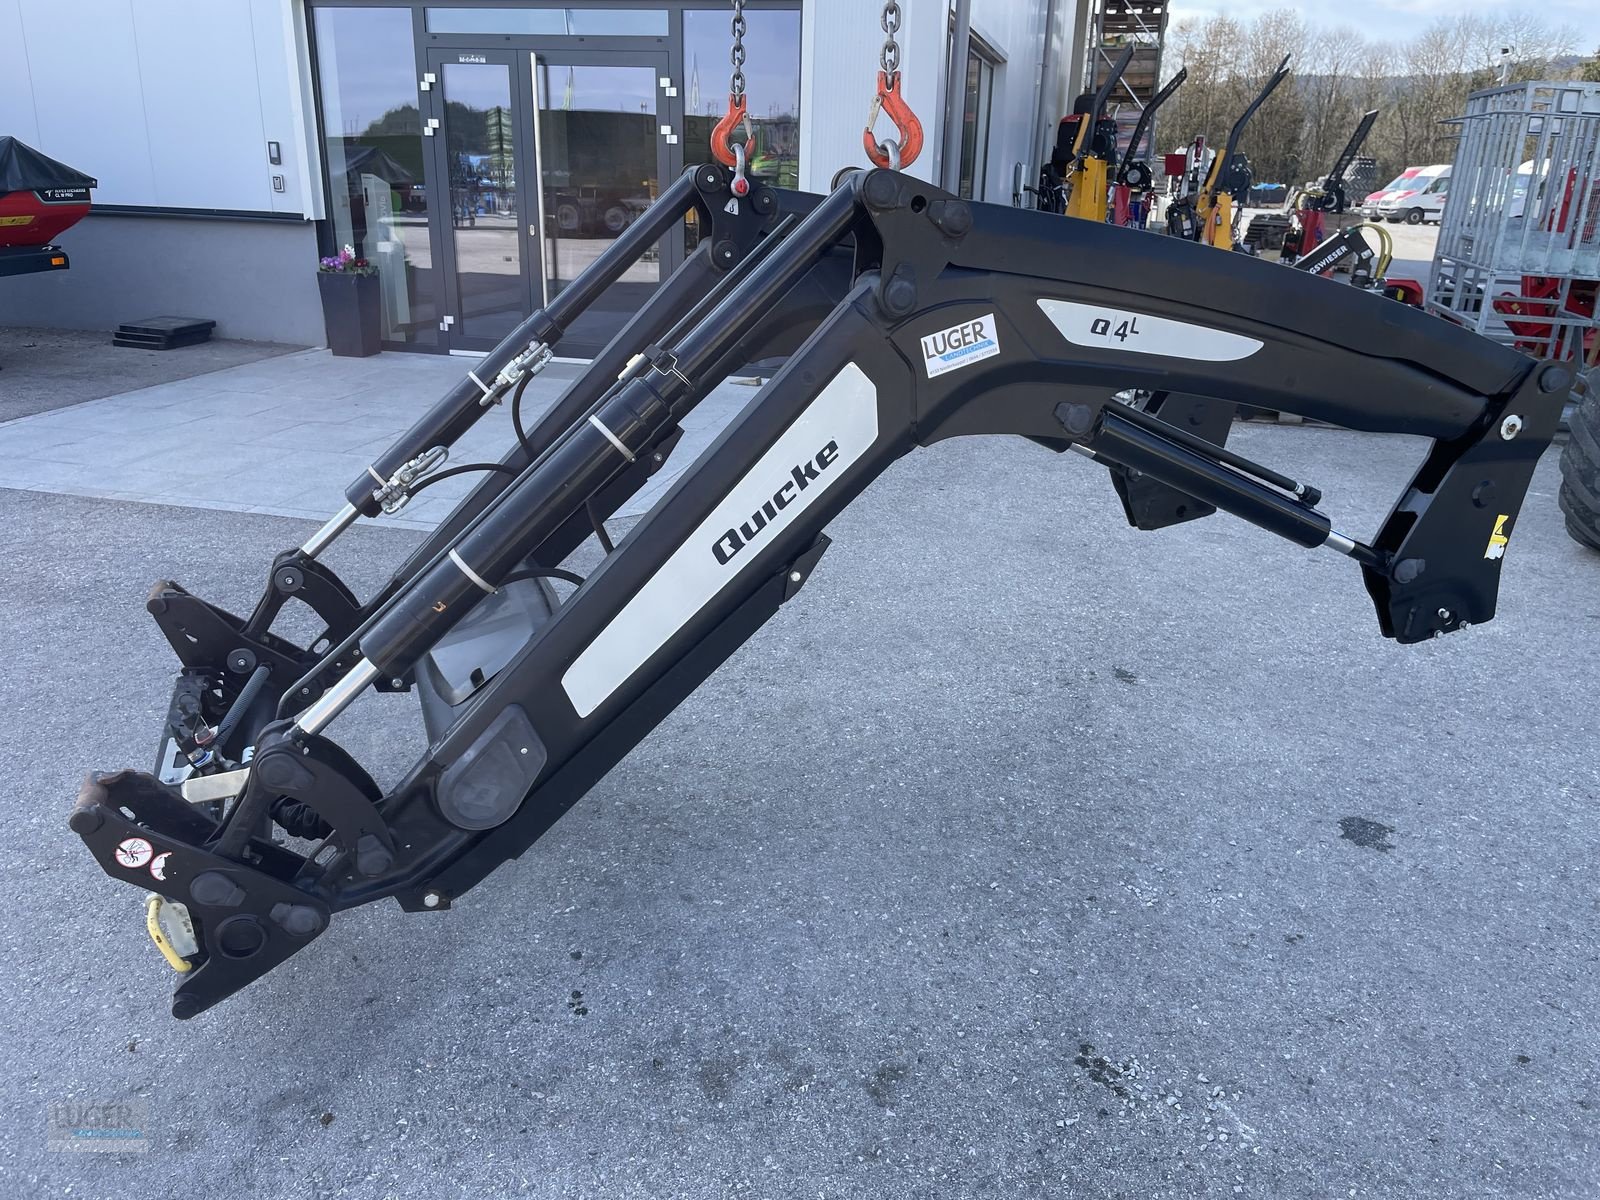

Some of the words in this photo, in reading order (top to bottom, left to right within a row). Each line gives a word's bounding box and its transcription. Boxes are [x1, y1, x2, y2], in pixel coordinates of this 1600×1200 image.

[1306, 245, 1349, 275] GSWIESER
[923, 321, 987, 360] LUGER
[712, 440, 839, 566] Quicke
